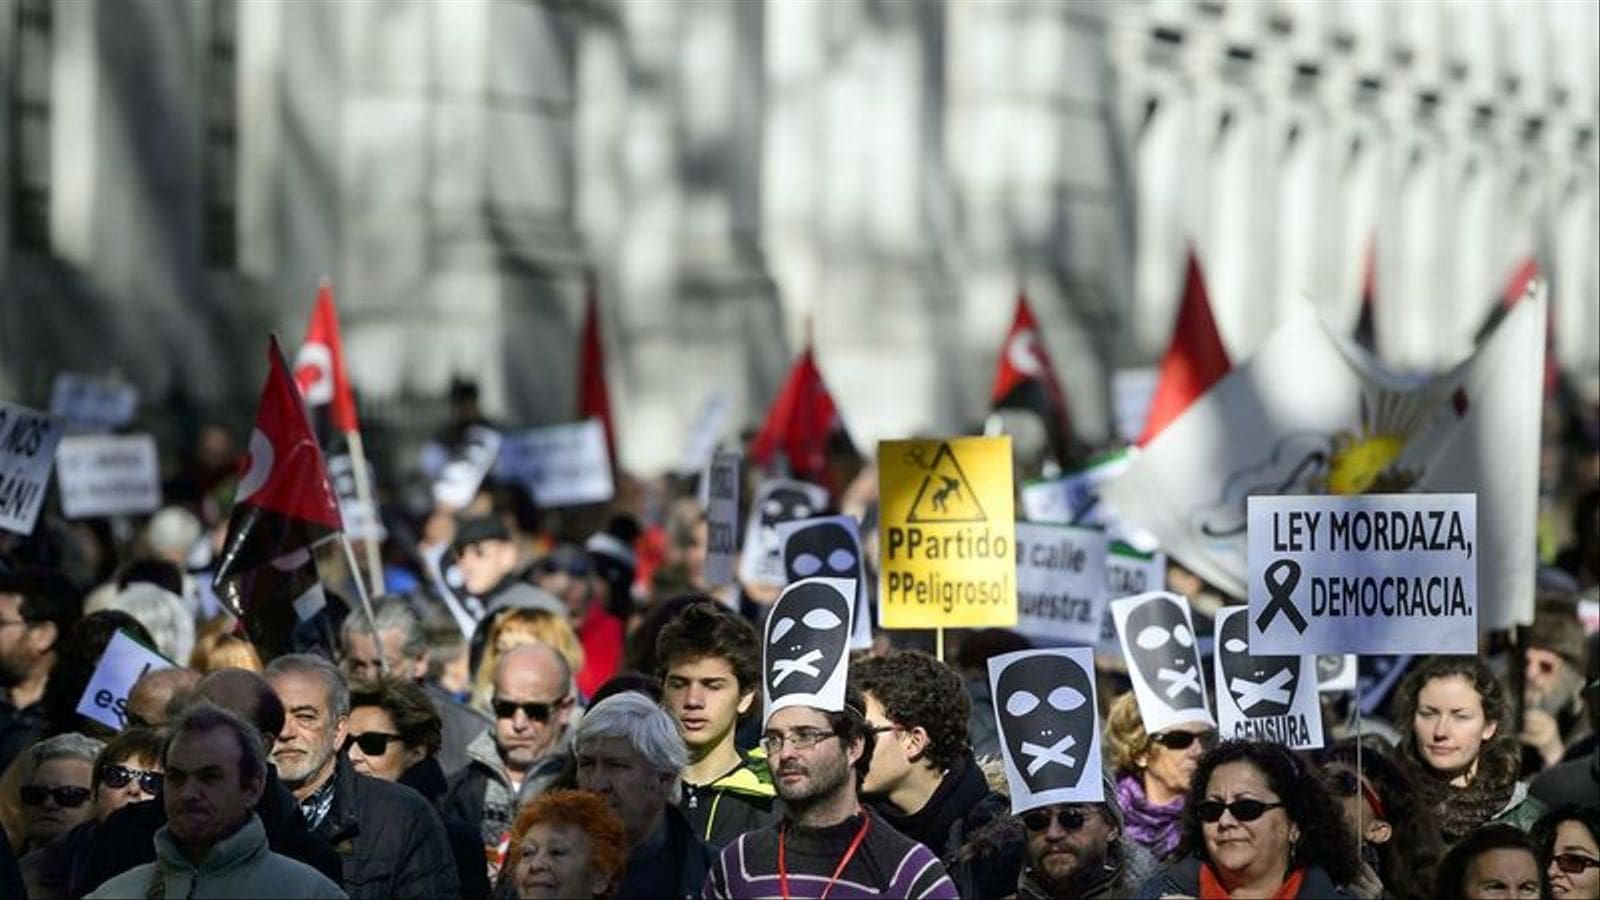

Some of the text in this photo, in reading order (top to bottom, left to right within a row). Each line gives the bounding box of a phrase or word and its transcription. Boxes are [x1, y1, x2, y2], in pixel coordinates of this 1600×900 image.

[888, 527, 1008, 560] PPartido
[1273, 510, 1473, 559] LEY MORDAZA,
[1031, 539, 1087, 574] calle
[887, 571, 1009, 613] PPeligroso!
[1311, 576, 1473, 617] DEMOCRACIA.
[1234, 713, 1311, 746] CENSURA
